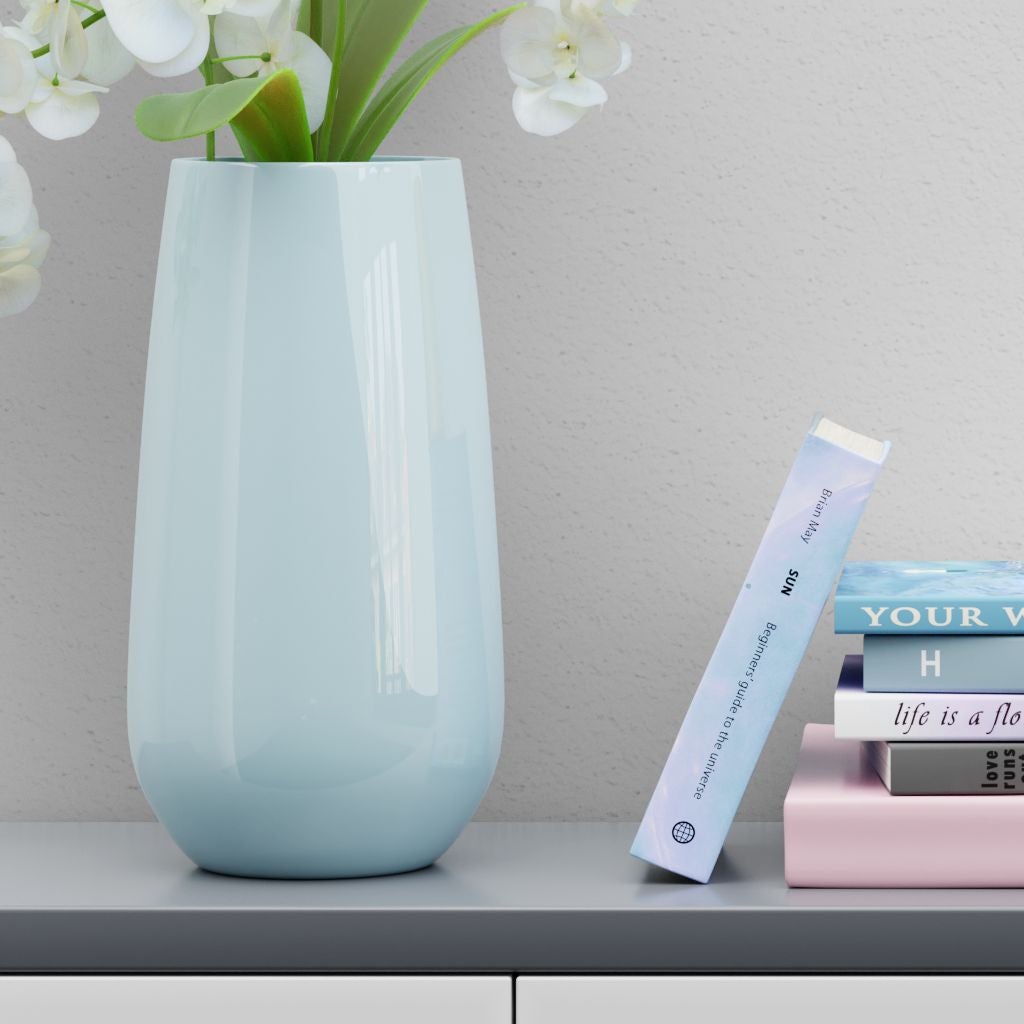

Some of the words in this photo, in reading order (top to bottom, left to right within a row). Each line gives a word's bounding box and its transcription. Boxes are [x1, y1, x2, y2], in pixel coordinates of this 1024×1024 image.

[812, 487, 833, 518] Brian
[800, 519, 820, 545] May
[780, 568, 799, 597] SUN
[860, 606, 989, 627] YOUR
[745, 621, 778, 683] Beginners'
[729, 680, 749, 714] guide
[723, 716, 735, 729] to
[893, 701, 931, 735] life
[940, 706, 959, 726] is
[968, 710, 984, 726] a
[713, 730, 729, 751] the
[693, 753, 719, 800] universe
[980, 750, 999, 788] love
[1003, 748, 1016, 790] runs
